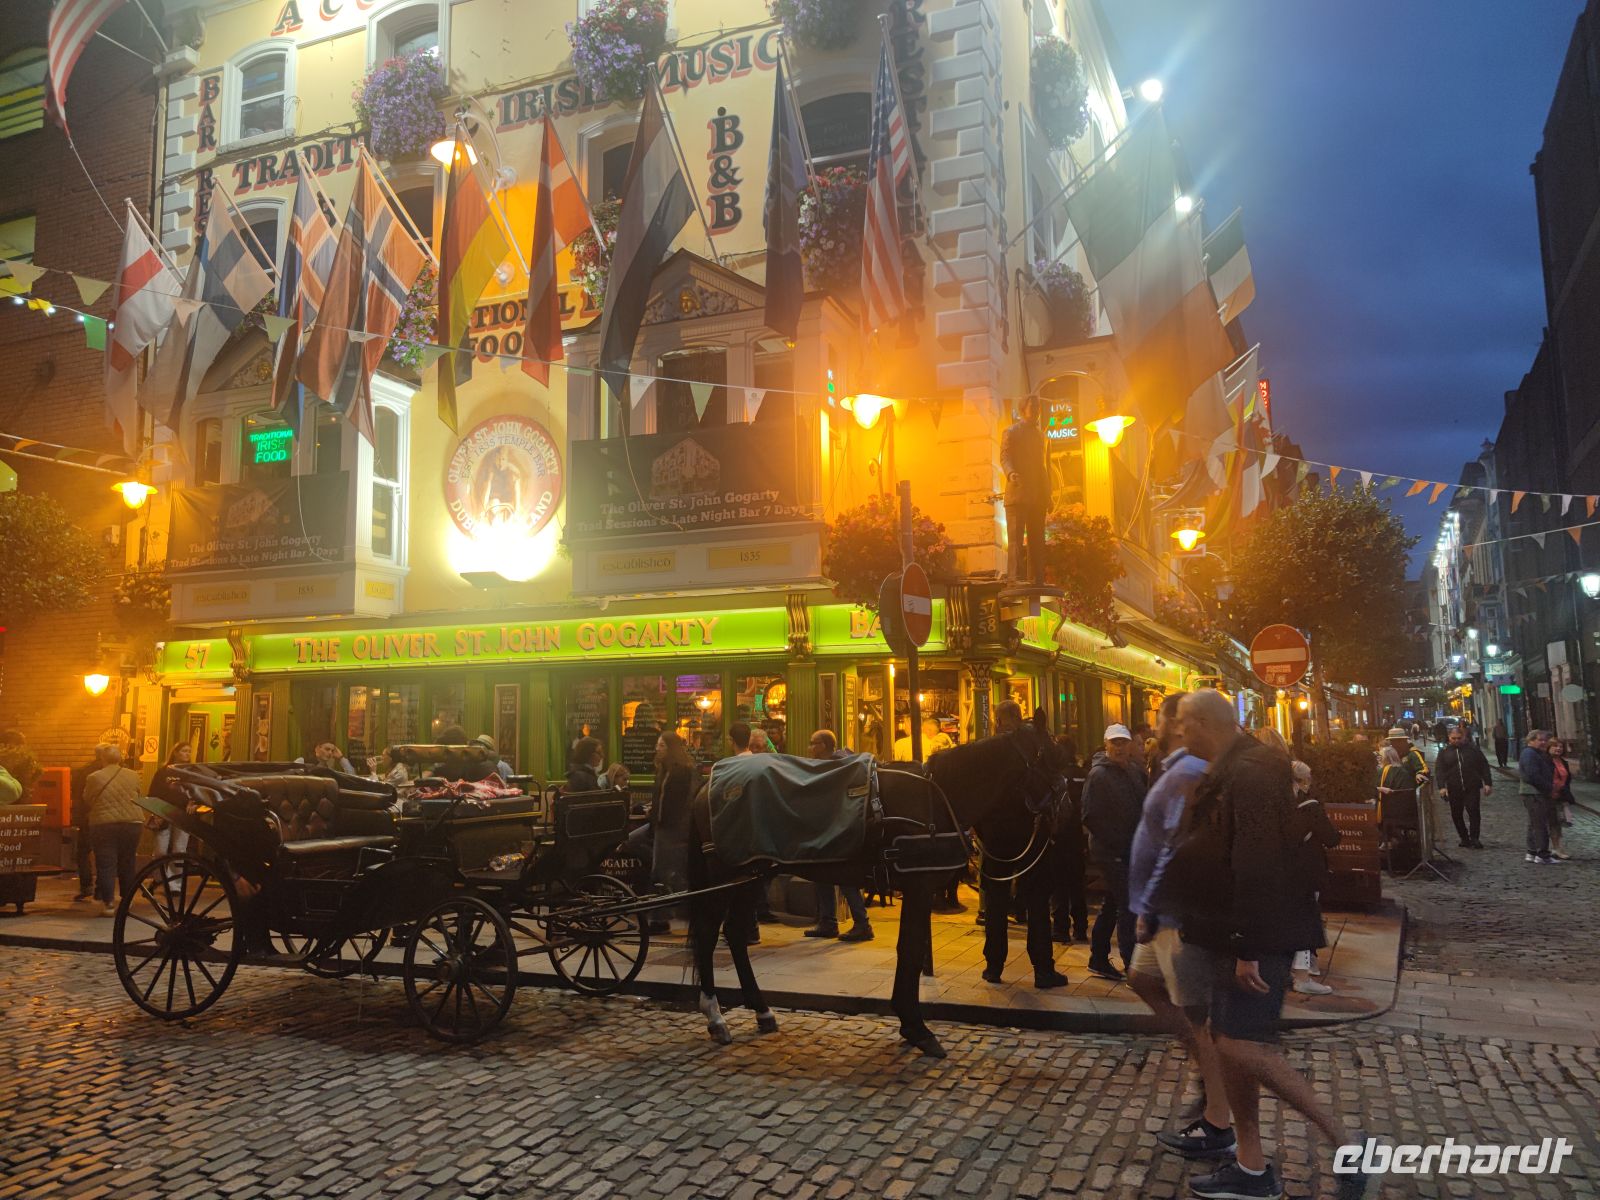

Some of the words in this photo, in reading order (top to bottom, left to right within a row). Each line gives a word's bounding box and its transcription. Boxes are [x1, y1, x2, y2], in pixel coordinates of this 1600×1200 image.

[492, 421, 521, 434] JOHN
[1047, 427, 1078, 439] MUSIC
[256, 438, 286, 451] IRISH
[255, 449, 287, 463] FOOD
[600, 503, 625, 514] The
[669, 499, 687, 509] St.
[690, 495, 722, 510] John
[725, 489, 780, 505] Gogarty
[672, 512, 698, 524] Late
[701, 508, 736, 522] Night
[739, 507, 760, 518] Bar
[763, 505, 771, 516] 7
[254, 537, 278, 551] John
[261, 551, 288, 562] Night
[294, 637, 341, 663] THE
[352, 632, 441, 661] OLIVER
[497, 625, 561, 654] JOHN
[577, 616, 719, 651] GOGARTY
[185, 643, 212, 669] 57
[15, 814, 41, 823] Music
[1334, 812, 1368, 821] Hostel
[16, 857, 33, 865] Bar
